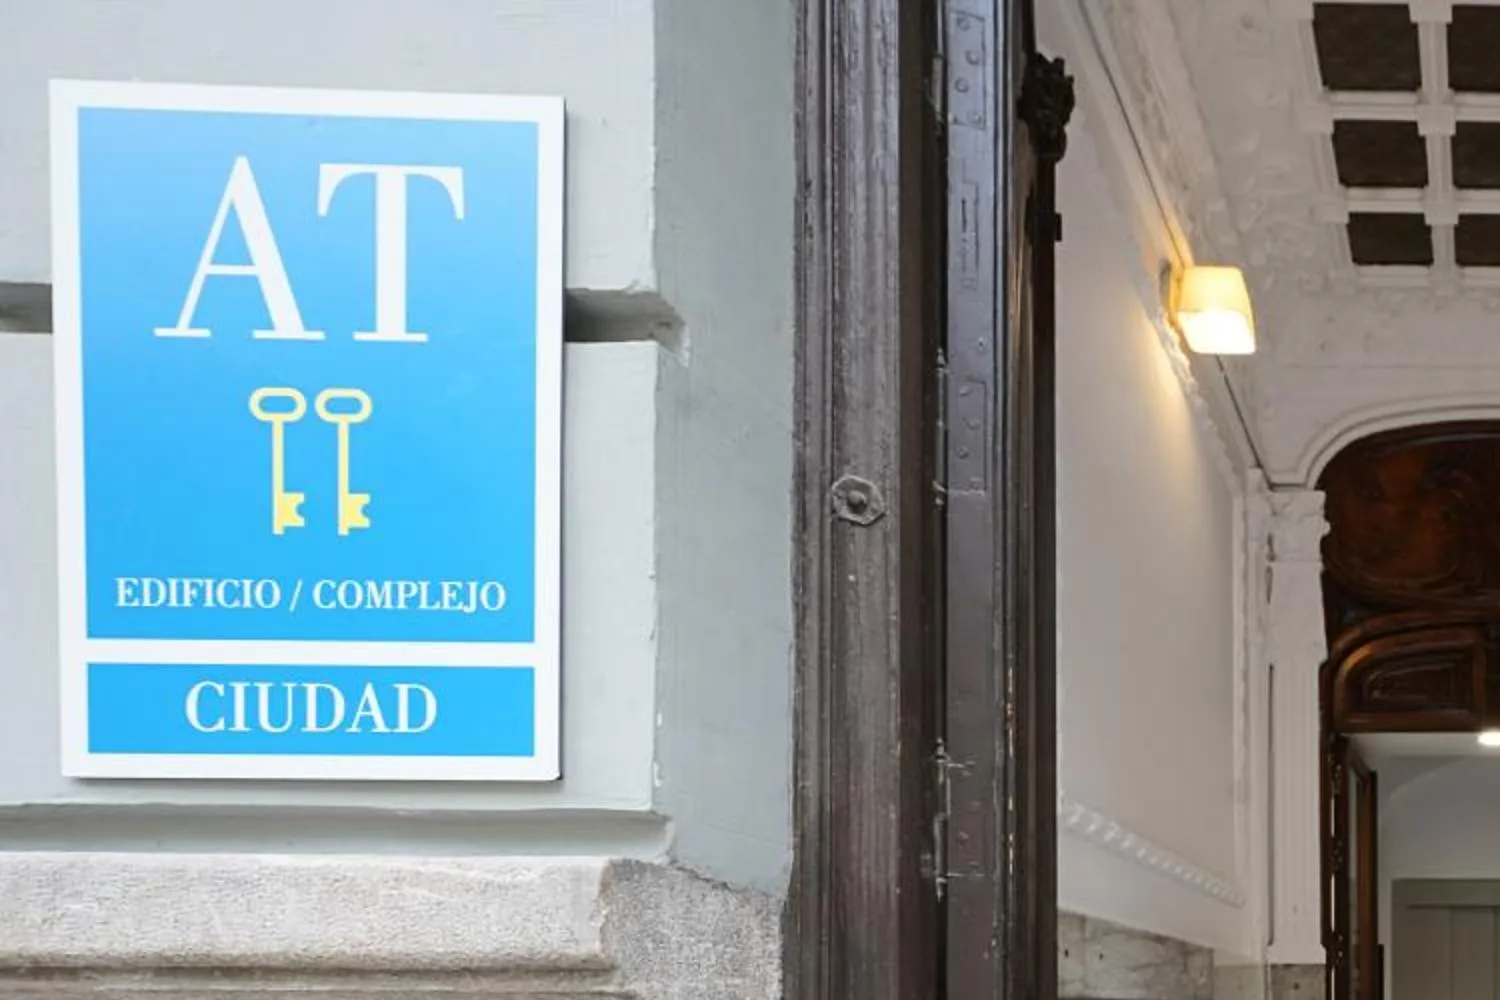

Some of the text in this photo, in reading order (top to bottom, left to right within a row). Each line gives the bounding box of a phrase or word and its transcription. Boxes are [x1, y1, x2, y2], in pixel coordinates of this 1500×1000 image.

[153, 155, 465, 343] AT
[115, 577, 506, 614] EDIFICIO / COMPLEJO
[185, 681, 438, 734] CIUDAD
